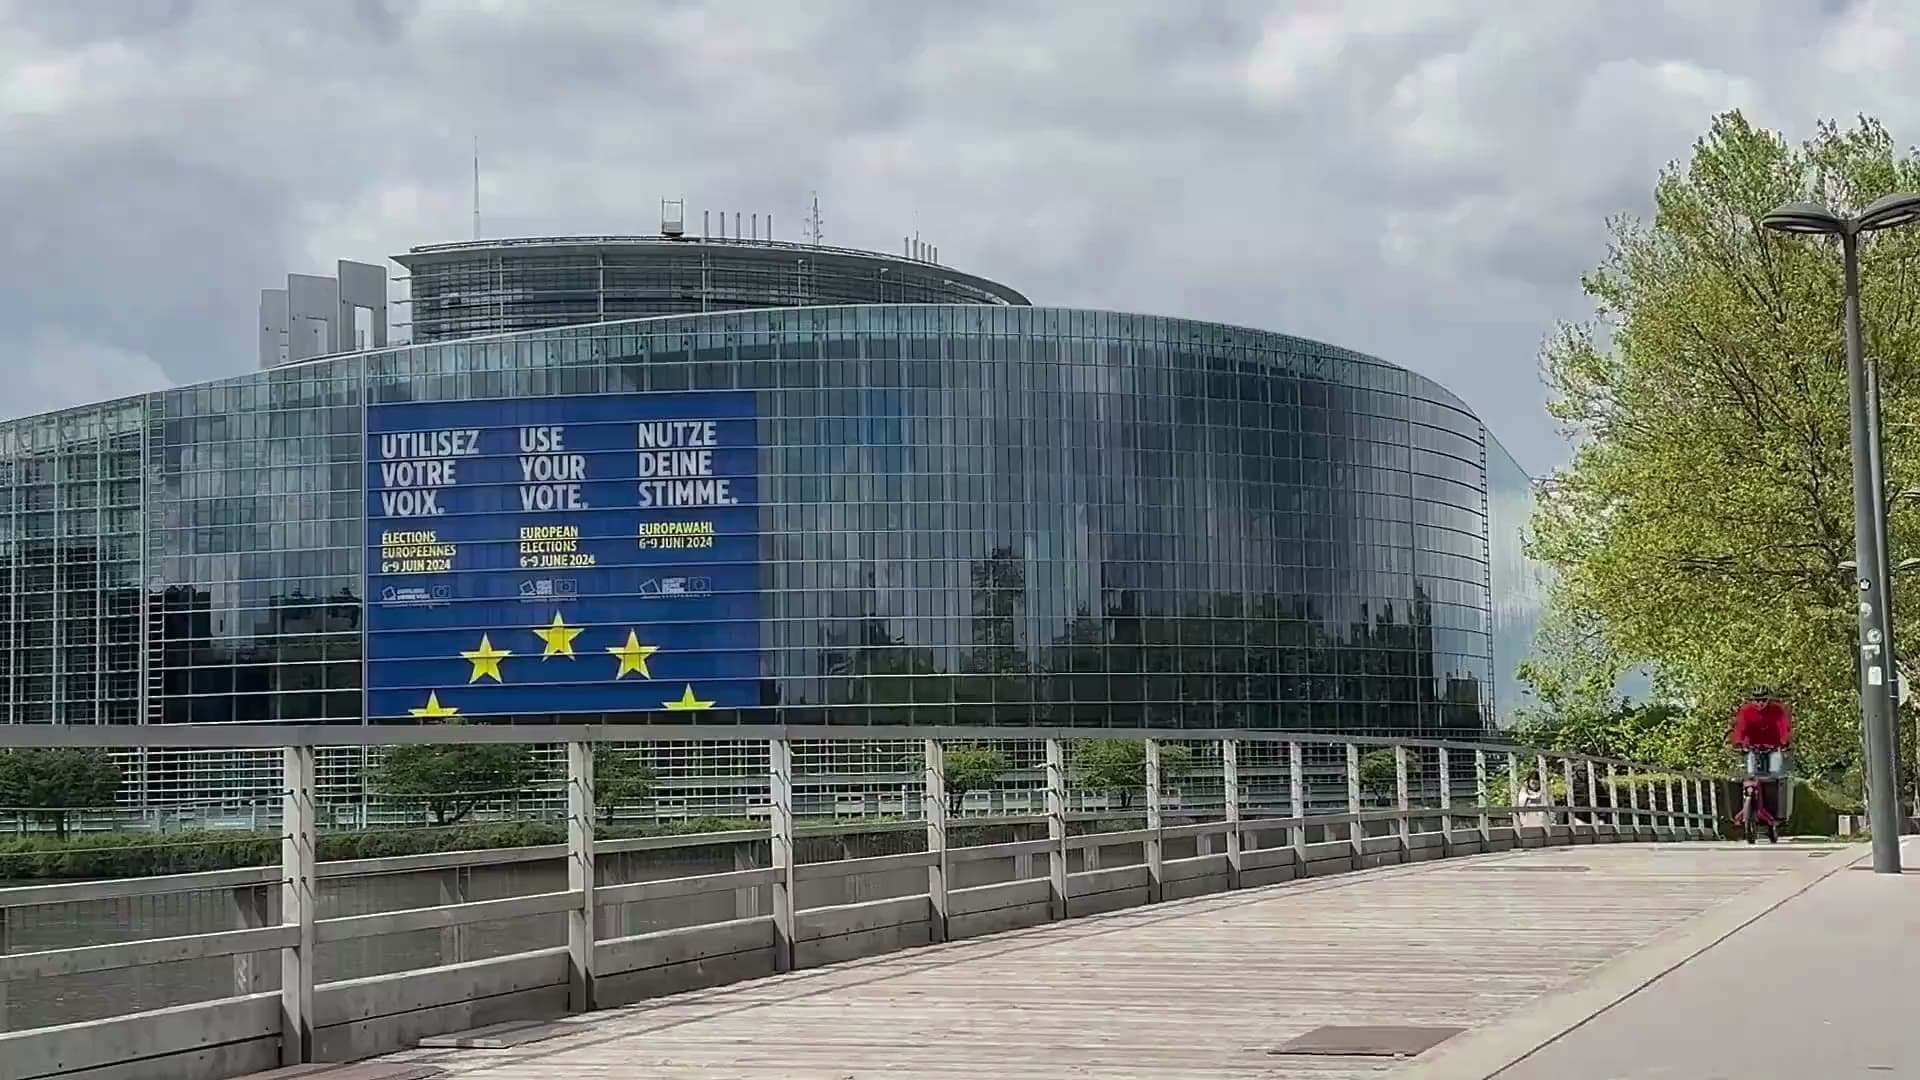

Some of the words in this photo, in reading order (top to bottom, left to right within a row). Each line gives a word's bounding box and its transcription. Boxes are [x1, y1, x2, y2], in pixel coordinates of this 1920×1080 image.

[381, 430, 480, 458] UTILISEZ
[519, 427, 565, 452] USE
[638, 422, 718, 448] NUTZE
[381, 460, 457, 487] VOTRE
[519, 455, 586, 481] YOUR
[639, 451, 713, 476] DEINE
[381, 490, 446, 516] VOIX.
[519, 484, 589, 511] VOTE.
[638, 480, 739, 507] STIMME.
[520, 525, 578, 539] EUROPEAN
[639, 522, 715, 535] EUROPAWAHL
[520, 541, 577, 553] ELECTIONS
[659, 537, 685, 549] JUNI
[686, 536, 713, 549] 2024
[400, 560, 425, 572] JUIN
[426, 559, 451, 570] 2024
[539, 554, 569, 567] JUNE
[569, 553, 596, 566] 2024
